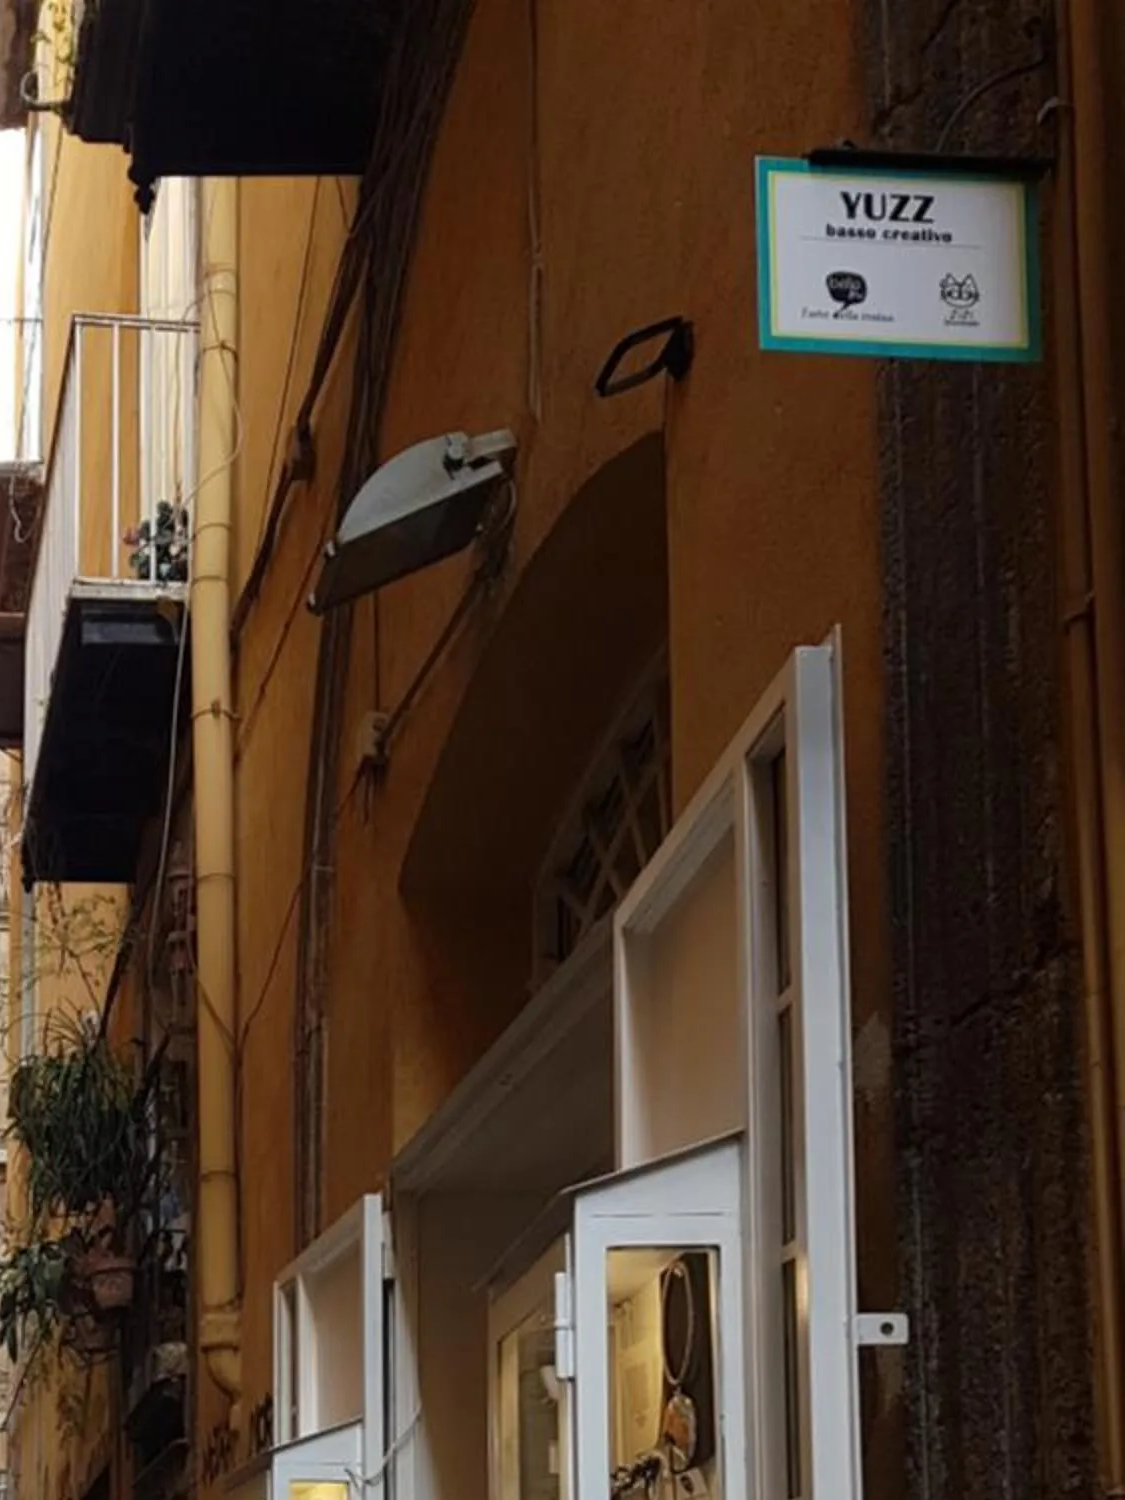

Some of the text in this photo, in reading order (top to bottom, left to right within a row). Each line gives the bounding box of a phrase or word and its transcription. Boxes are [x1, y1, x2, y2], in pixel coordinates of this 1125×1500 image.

[840, 191, 935, 224] YUZZ
[826, 224, 953, 243] basso creativo
